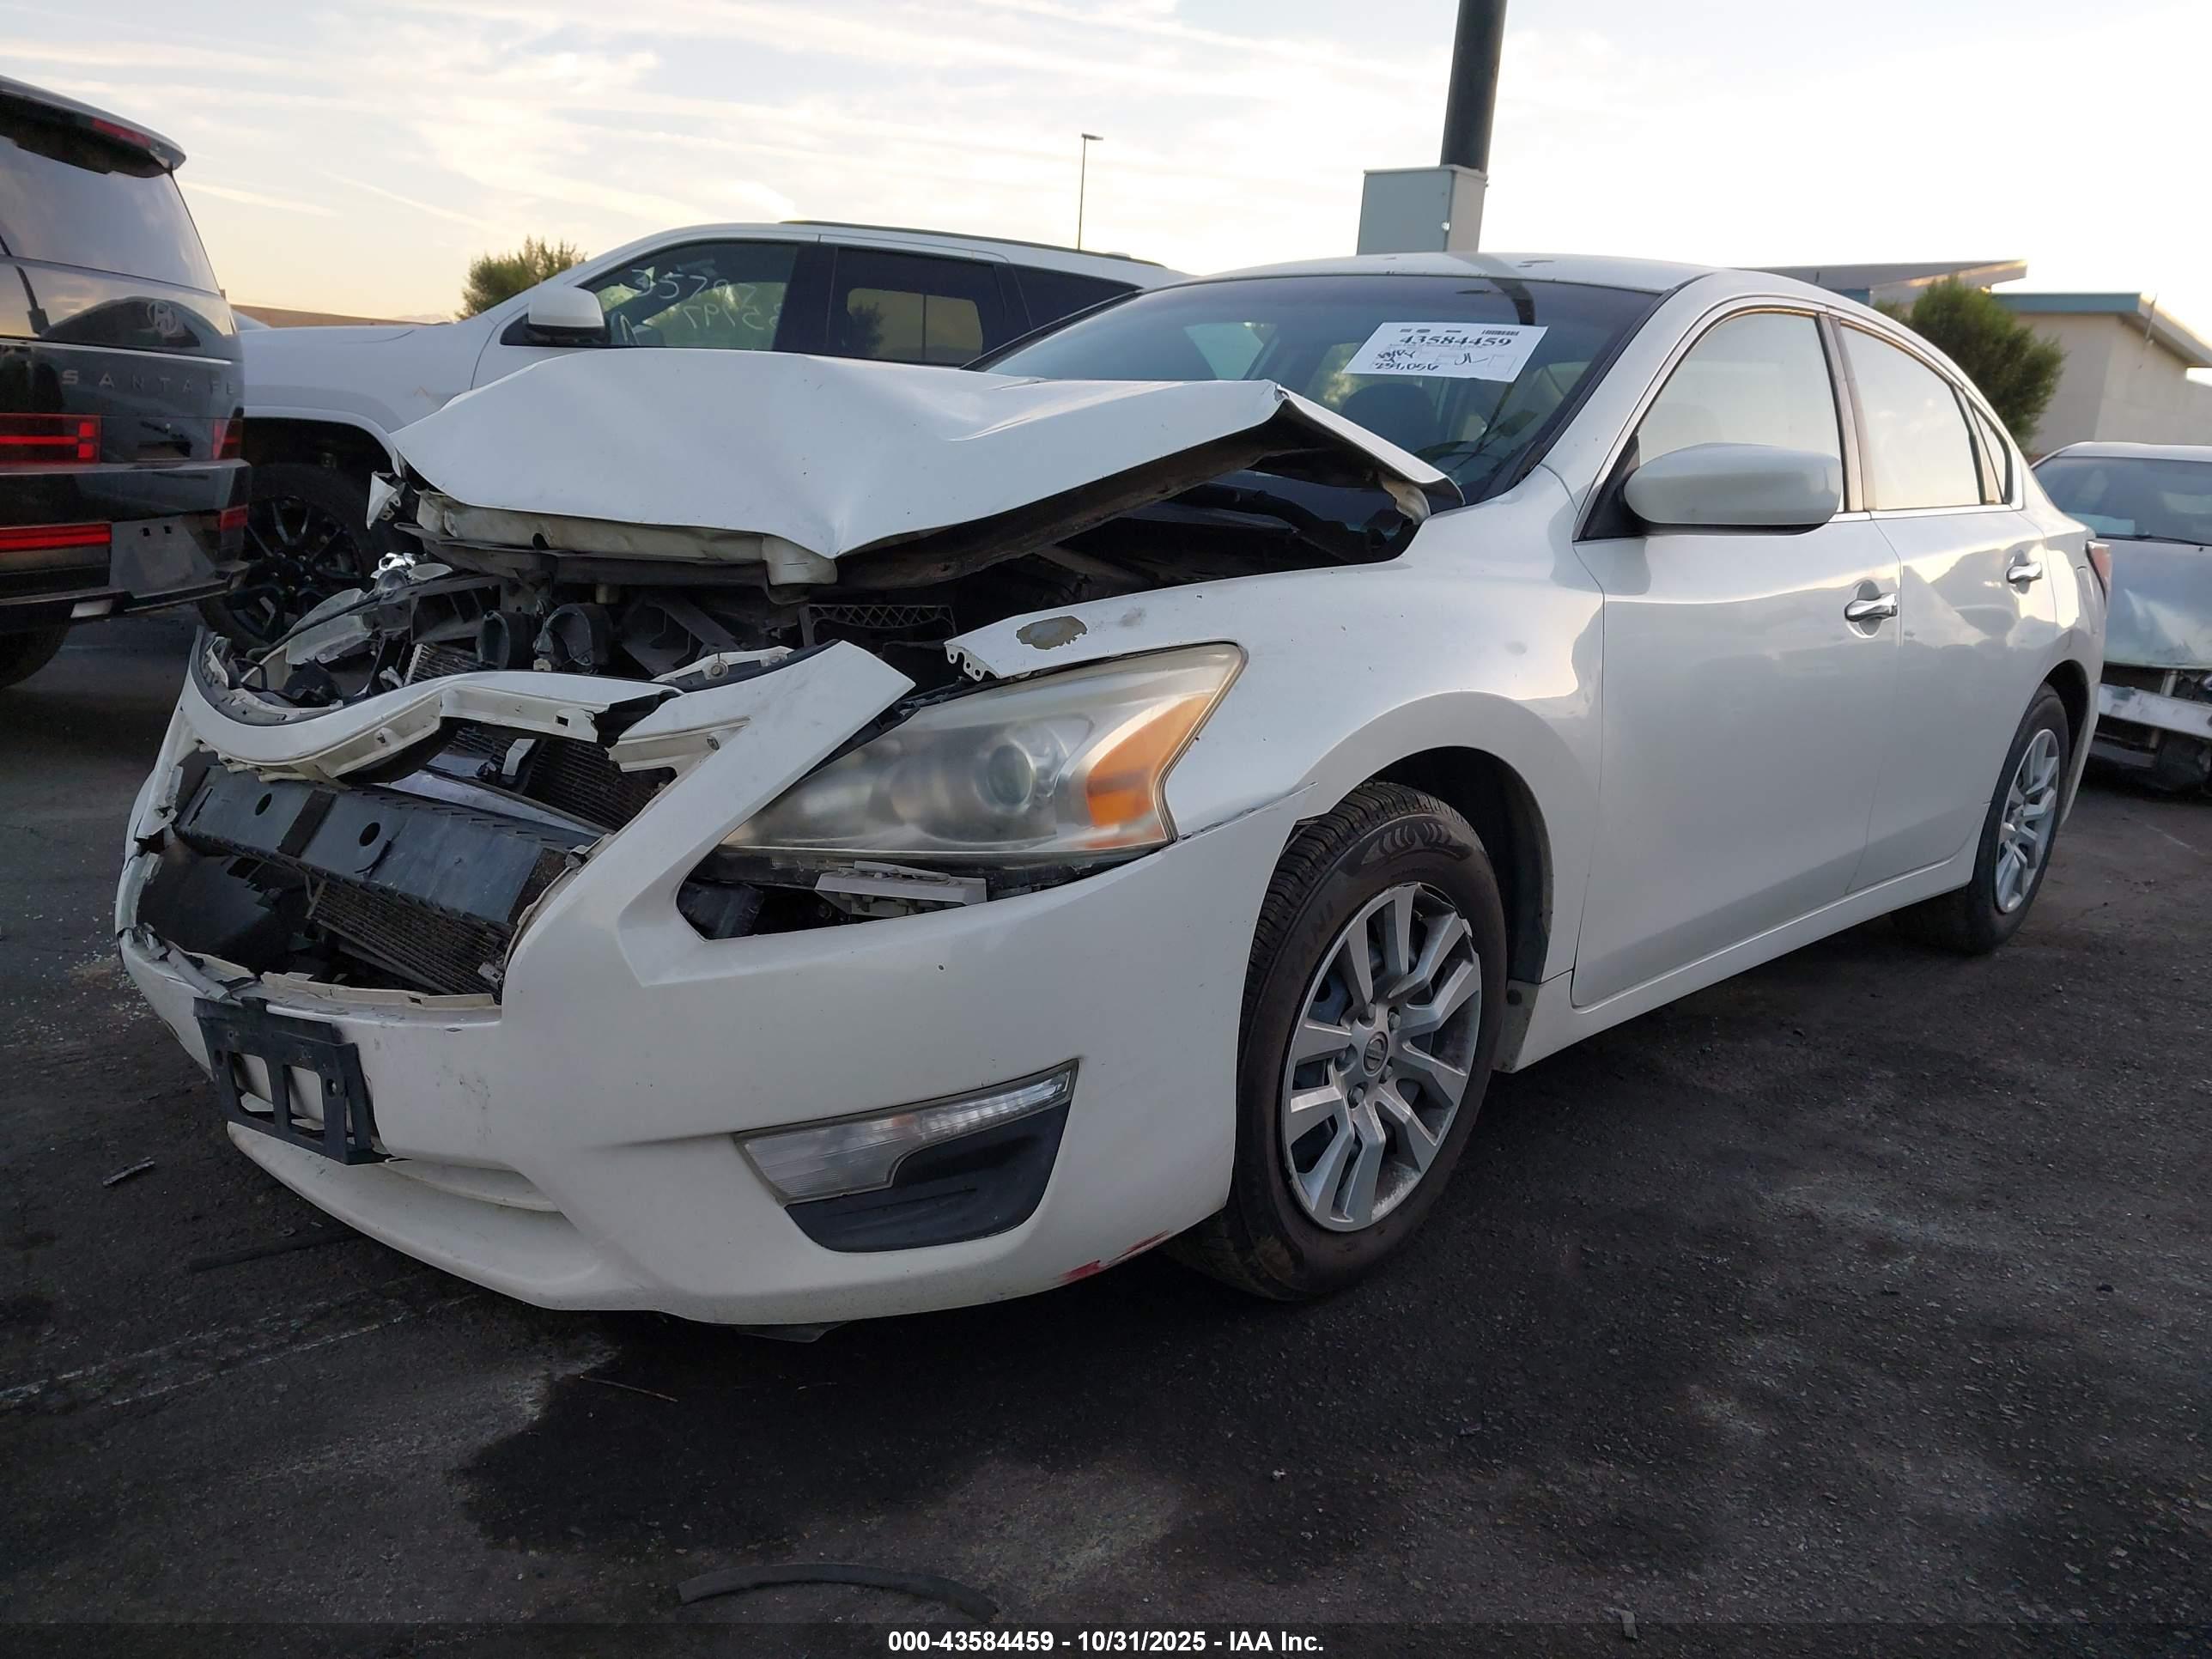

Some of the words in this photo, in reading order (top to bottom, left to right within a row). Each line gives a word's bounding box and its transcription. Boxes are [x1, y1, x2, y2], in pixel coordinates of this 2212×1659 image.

[1400, 335, 1512, 347] 43584459
[61, 368, 194, 393] SANTA
[210, 380, 234, 395] FE
